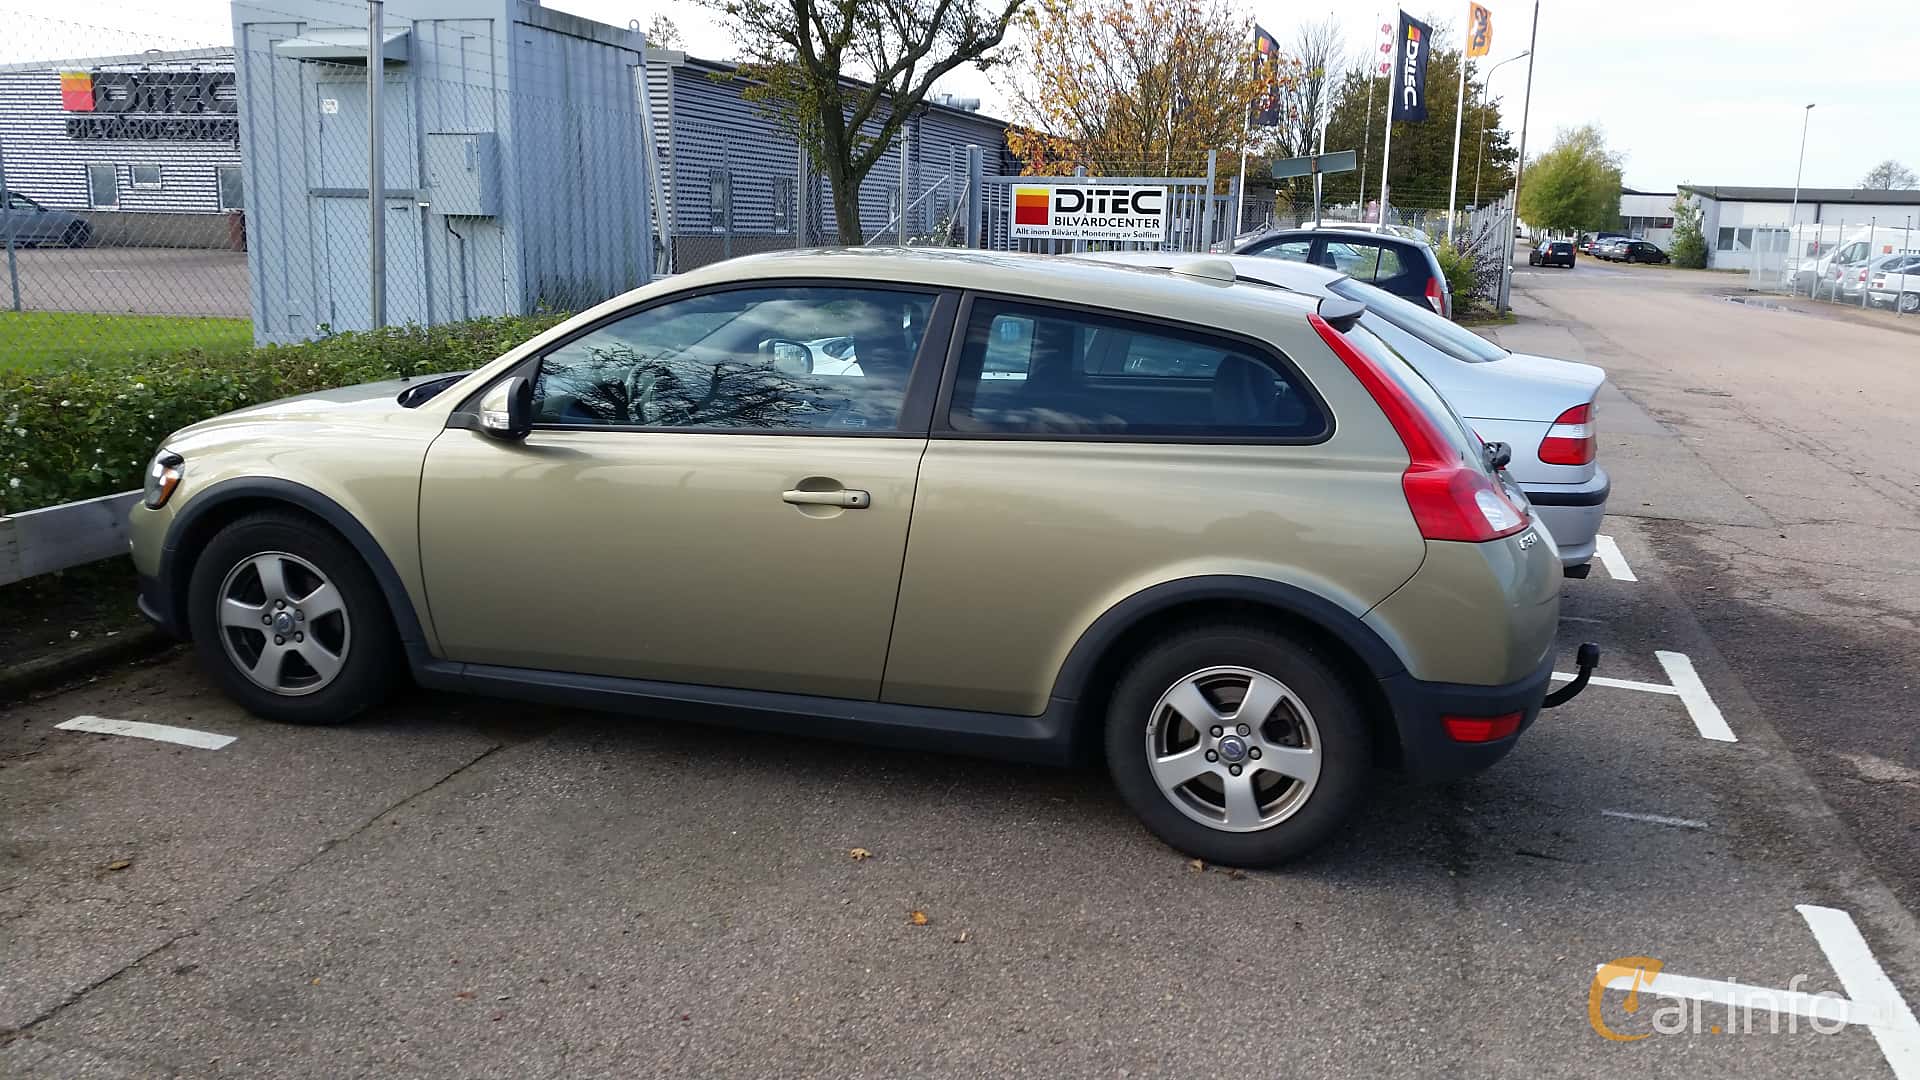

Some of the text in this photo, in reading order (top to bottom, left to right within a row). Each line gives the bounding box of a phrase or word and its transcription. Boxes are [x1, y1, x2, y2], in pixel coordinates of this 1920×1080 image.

[1054, 215, 1160, 228] BILVÅRDCENTER
[1051, 229, 1080, 237] Bilvård,
[1081, 229, 1121, 239] Montering
[1133, 231, 1160, 239] Solfilm
